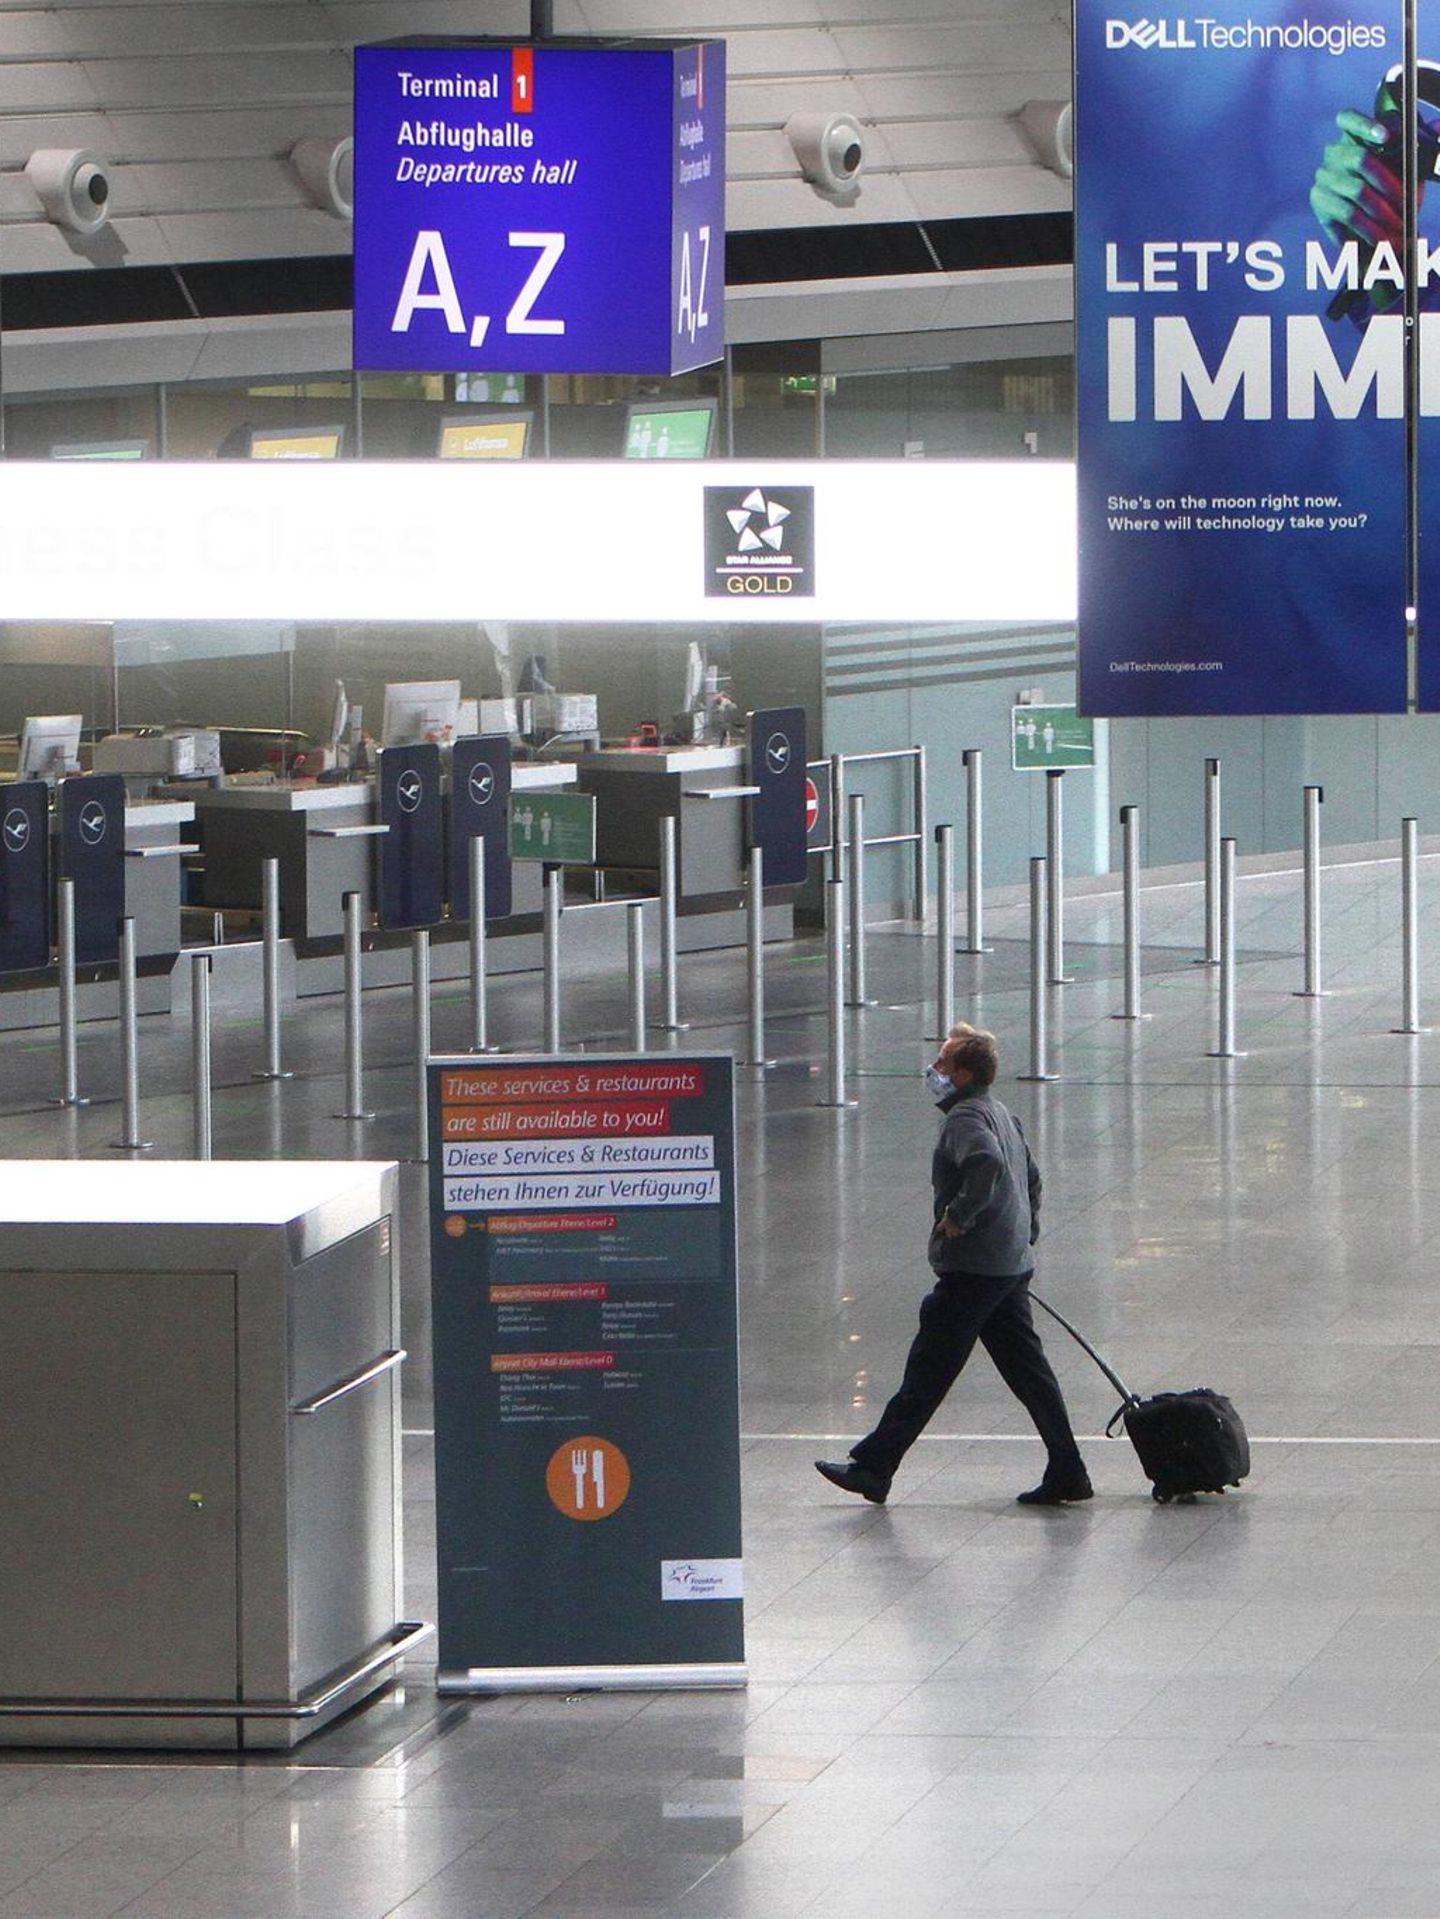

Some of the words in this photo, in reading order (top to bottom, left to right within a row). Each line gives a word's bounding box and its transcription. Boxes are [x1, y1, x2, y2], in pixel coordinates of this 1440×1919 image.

[1196, 19, 1386, 55] Technologies
[398, 72, 498, 98] Terminal
[516, 75, 527, 98] 1
[398, 121, 533, 152] Abflughalle
[396, 158, 523, 187] Departures
[532, 160, 577, 184] hall
[1106, 241, 1285, 292] LET’S
[391, 230, 565, 347] A,Z
[1108, 313, 1440, 421] IMM
[1108, 496, 1151, 510] She's
[1156, 499, 1175, 509] on
[1181, 496, 1207, 509] the
[1211, 498, 1256, 509] moon
[1261, 494, 1299, 511] right
[1304, 497, 1342, 508] now.
[1108, 516, 1159, 531] Where
[1165, 516, 1191, 529] will
[1196, 515, 1285, 532] technology
[1290, 515, 1324, 528] take
[1329, 513, 1367, 530] you?
[727, 576, 792, 593] GOLD
[1109, 660, 1223, 673] DellTechnologies.com
[447, 1077, 497, 1096] These
[503, 1075, 569, 1094] services
[575, 1075, 590, 1092] &
[596, 1073, 695, 1092] restaurants
[447, 1117, 476, 1131] are
[482, 1111, 511, 1131] still
[516, 1110, 597, 1130] available
[602, 1111, 620, 1128] to
[625, 1108, 664, 1131] you!
[448, 1148, 498, 1166] Diese
[503, 1145, 574, 1165] Services
[580, 1145, 595, 1163] &
[601, 1142, 709, 1162] Restaurants
[449, 1182, 509, 1202] stehen
[516, 1180, 569, 1200] Ihnen
[575, 1184, 603, 1199] zur
[609, 1177, 714, 1202] Verfügung!
